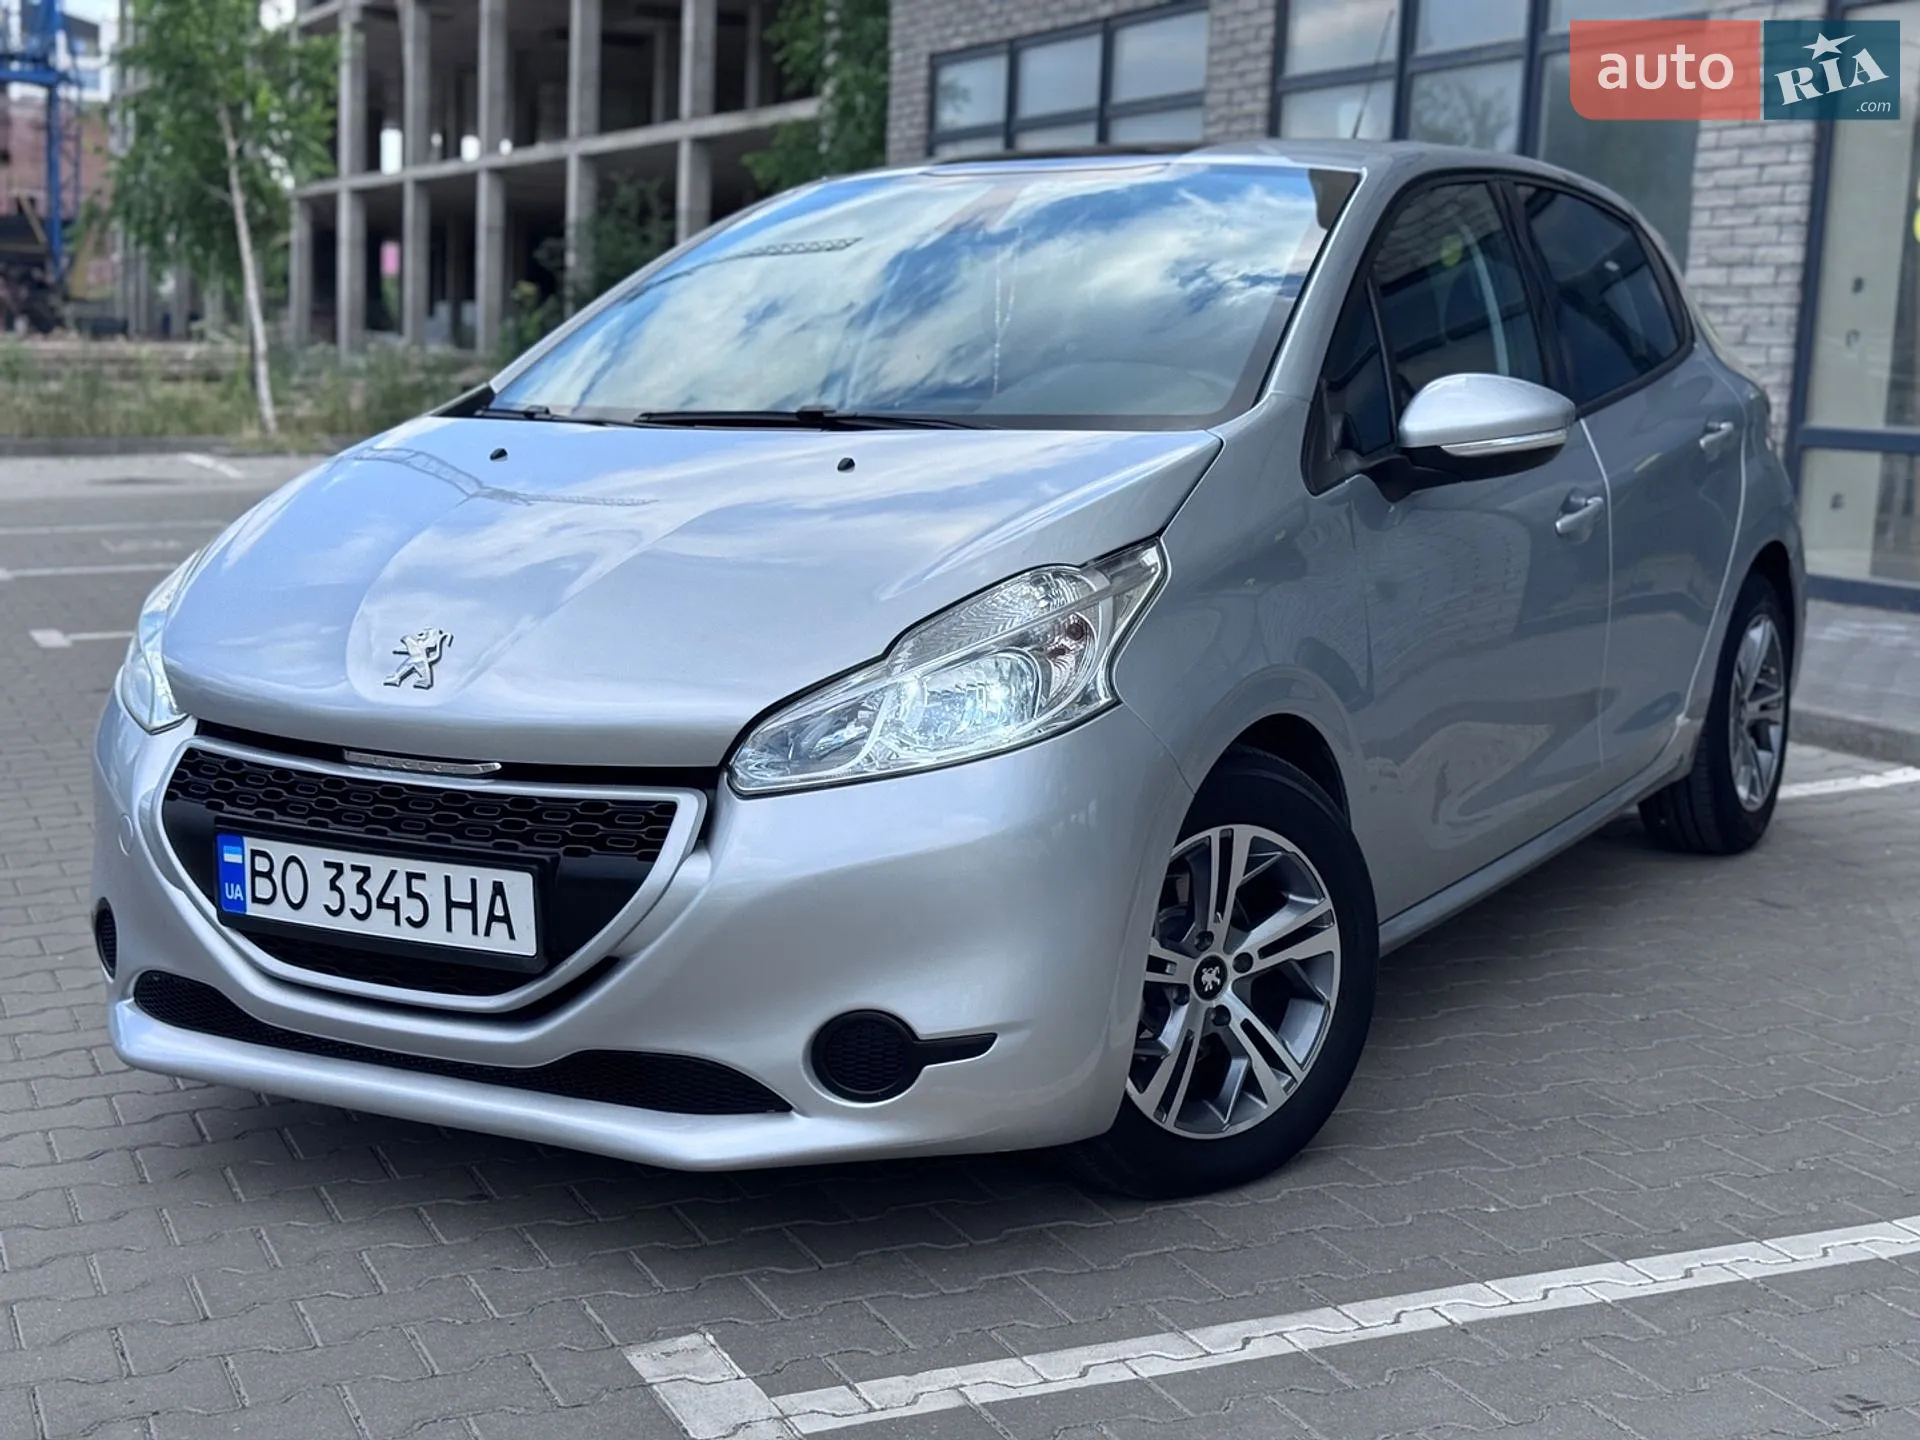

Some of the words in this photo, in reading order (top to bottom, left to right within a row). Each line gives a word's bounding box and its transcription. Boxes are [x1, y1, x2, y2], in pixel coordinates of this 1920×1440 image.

[225, 882, 244, 901] UA
[250, 848, 309, 910] BO
[323, 860, 430, 929] 3345
[444, 874, 516, 940] HA
